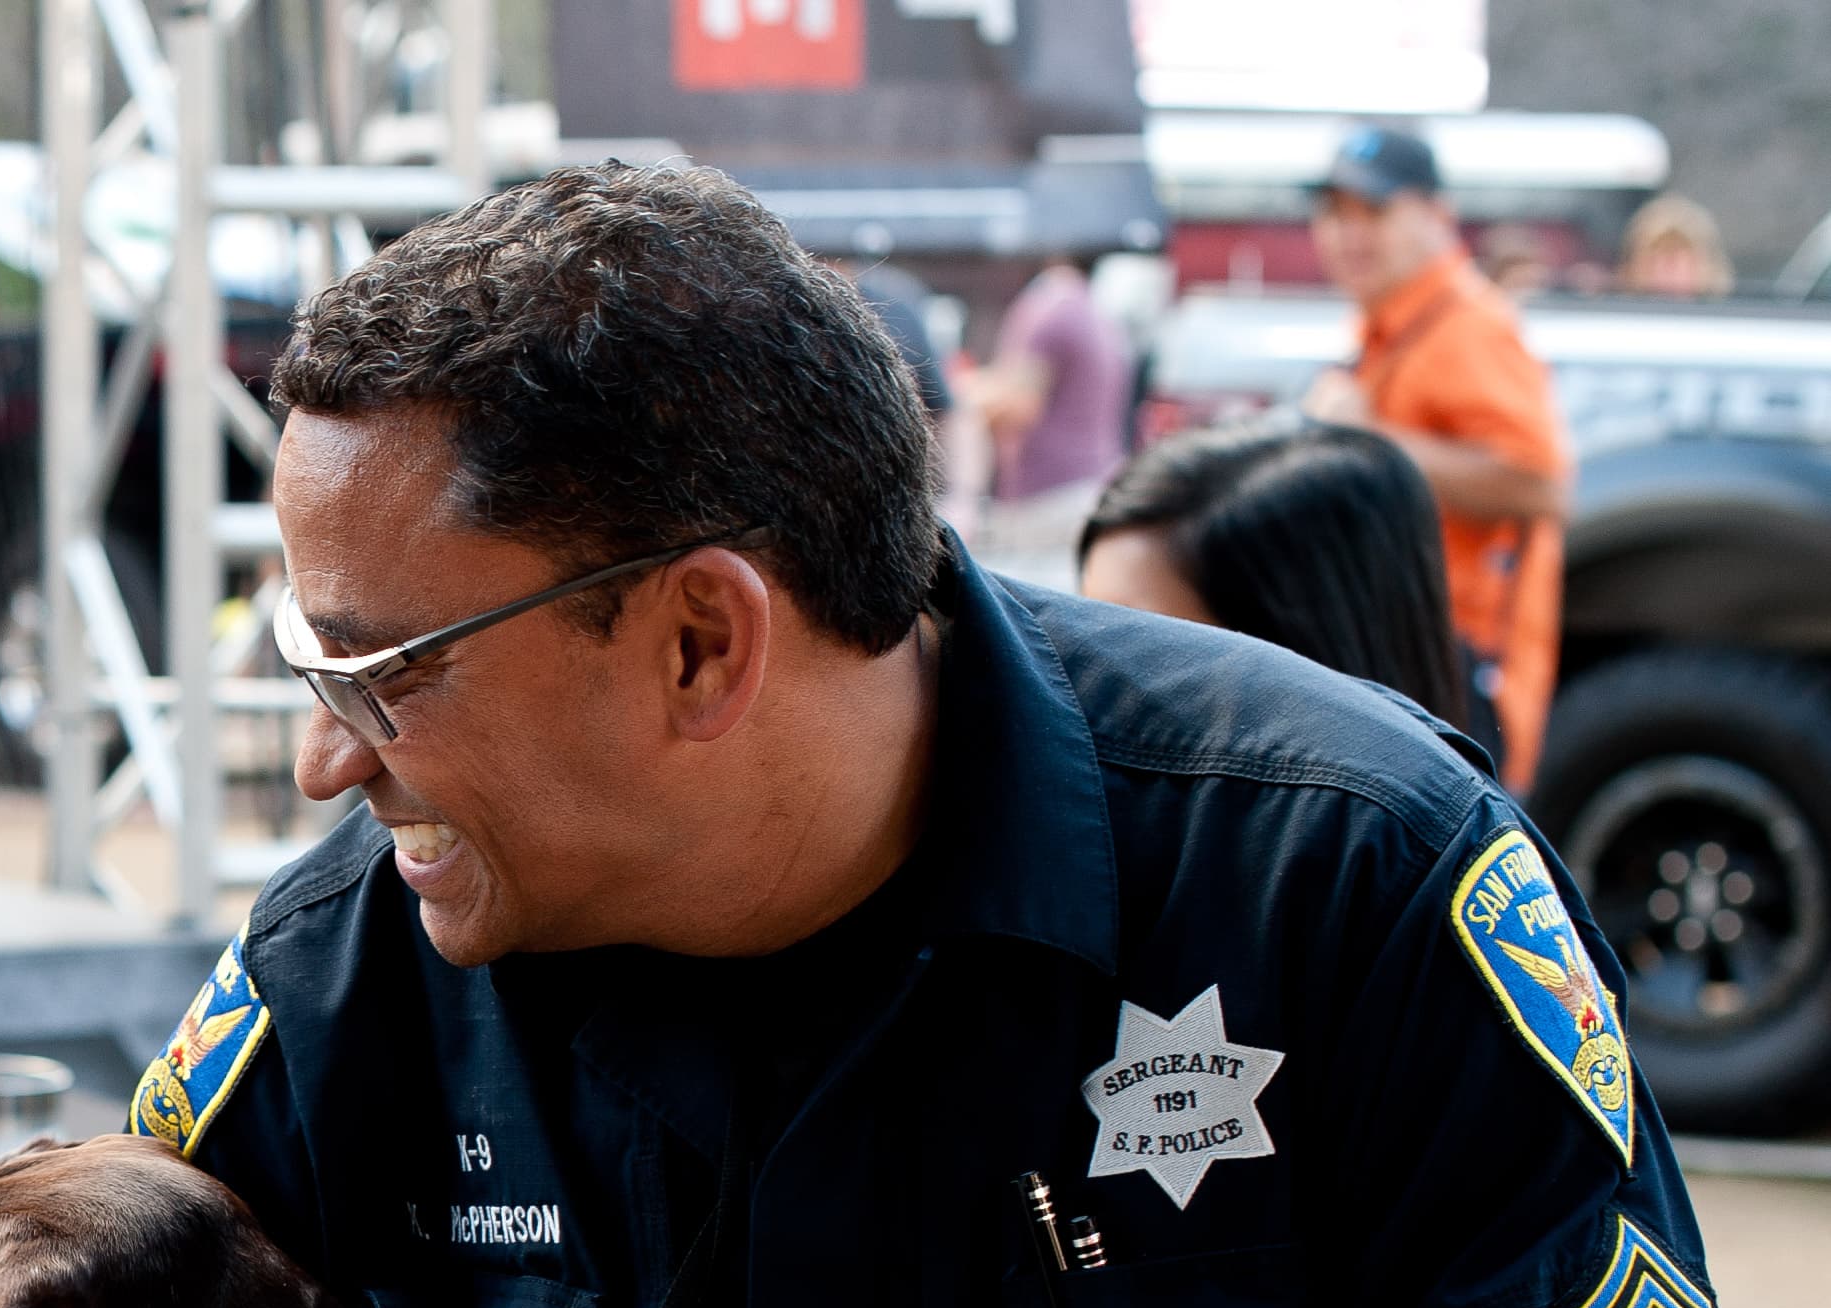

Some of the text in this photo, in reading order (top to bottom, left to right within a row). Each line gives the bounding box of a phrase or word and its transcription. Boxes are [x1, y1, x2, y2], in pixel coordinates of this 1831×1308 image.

[1467, 870, 1514, 935] SAN
[1102, 1052, 1244, 1097] SERGEANT
[1153, 1089, 1197, 1113] 1191
[457, 1133, 492, 1172] K-9
[1158, 1117, 1243, 1156] POLICE
[451, 1203, 561, 1246] McPHERSON
